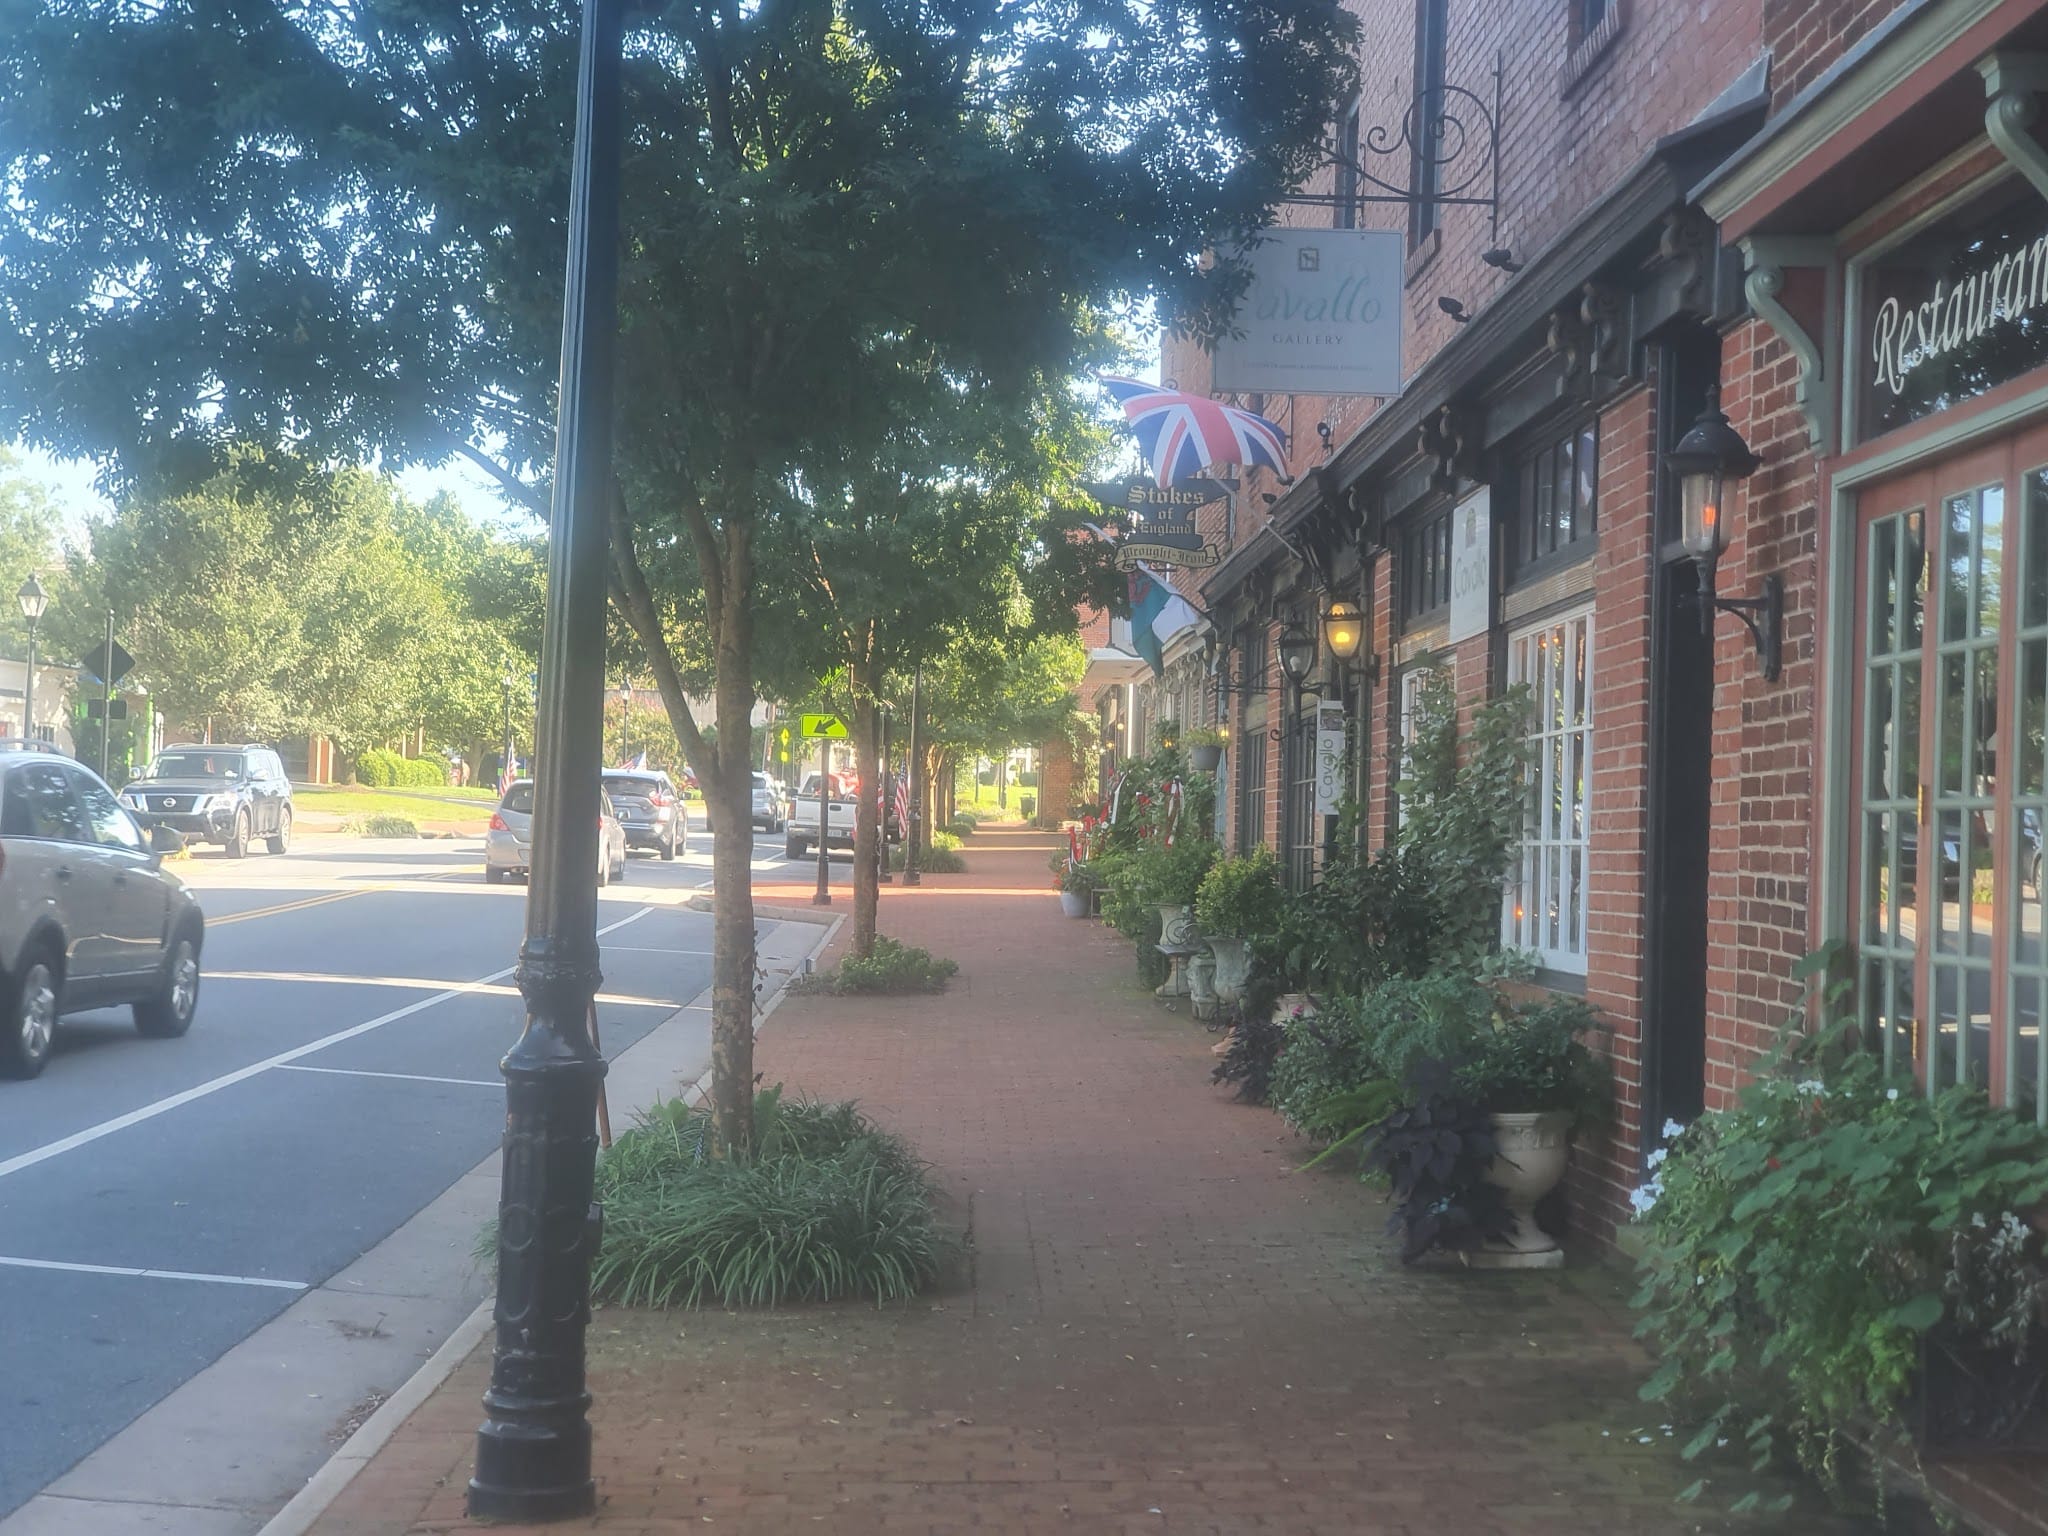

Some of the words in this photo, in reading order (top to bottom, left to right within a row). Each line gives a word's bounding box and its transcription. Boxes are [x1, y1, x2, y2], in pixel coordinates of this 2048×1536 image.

[1243, 264, 1383, 324] avallo
[1271, 333, 1345, 346] GALLERY
[1127, 484, 1205, 505] Stokes
[1157, 507, 1174, 520] of
[1139, 522, 1192, 536] England
[1318, 738, 1334, 799] Cavallo
